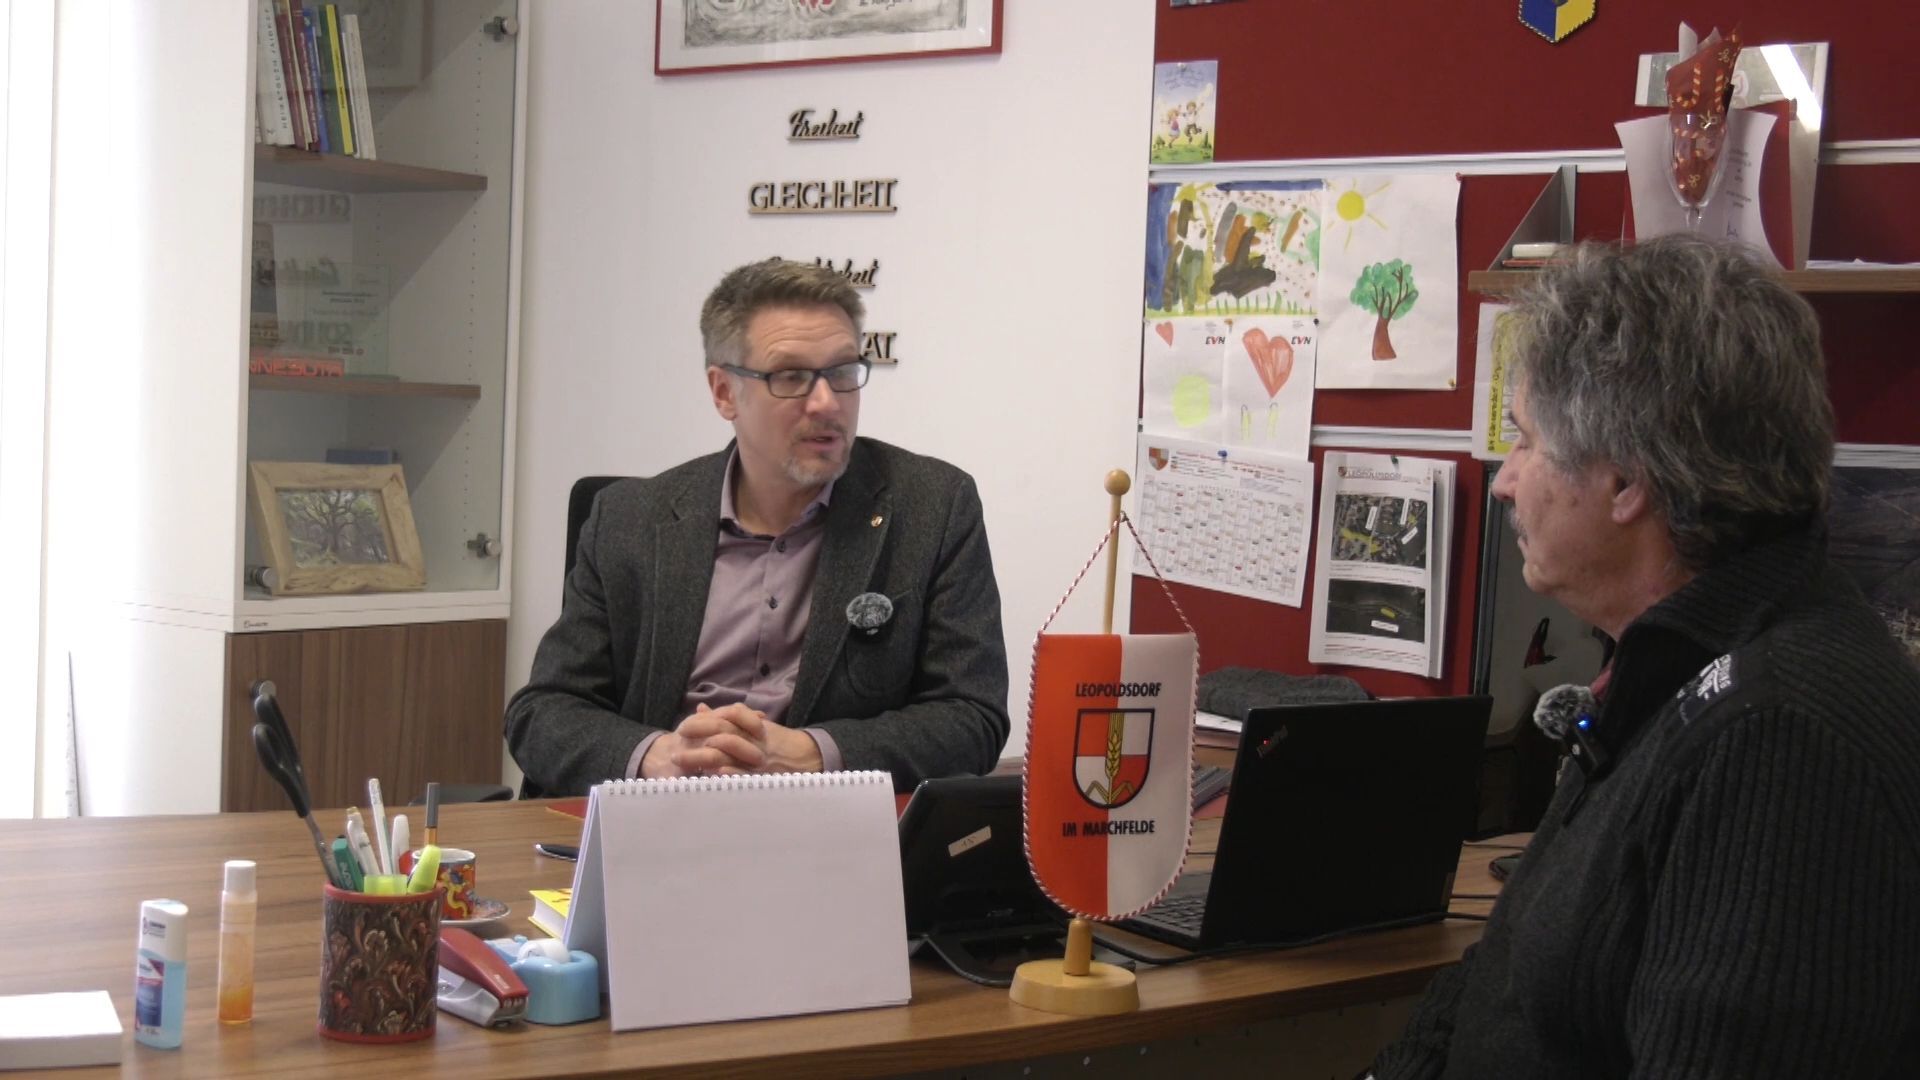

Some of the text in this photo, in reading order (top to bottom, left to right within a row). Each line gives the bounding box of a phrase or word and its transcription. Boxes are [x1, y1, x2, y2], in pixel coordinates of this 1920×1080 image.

[789, 109, 864, 138] Freiheit
[749, 179, 898, 212] GLEICHHEIT
[1075, 682, 1162, 698] LEOPOLDSDORF
[1062, 820, 1155, 837] IM MARCHFELDE
